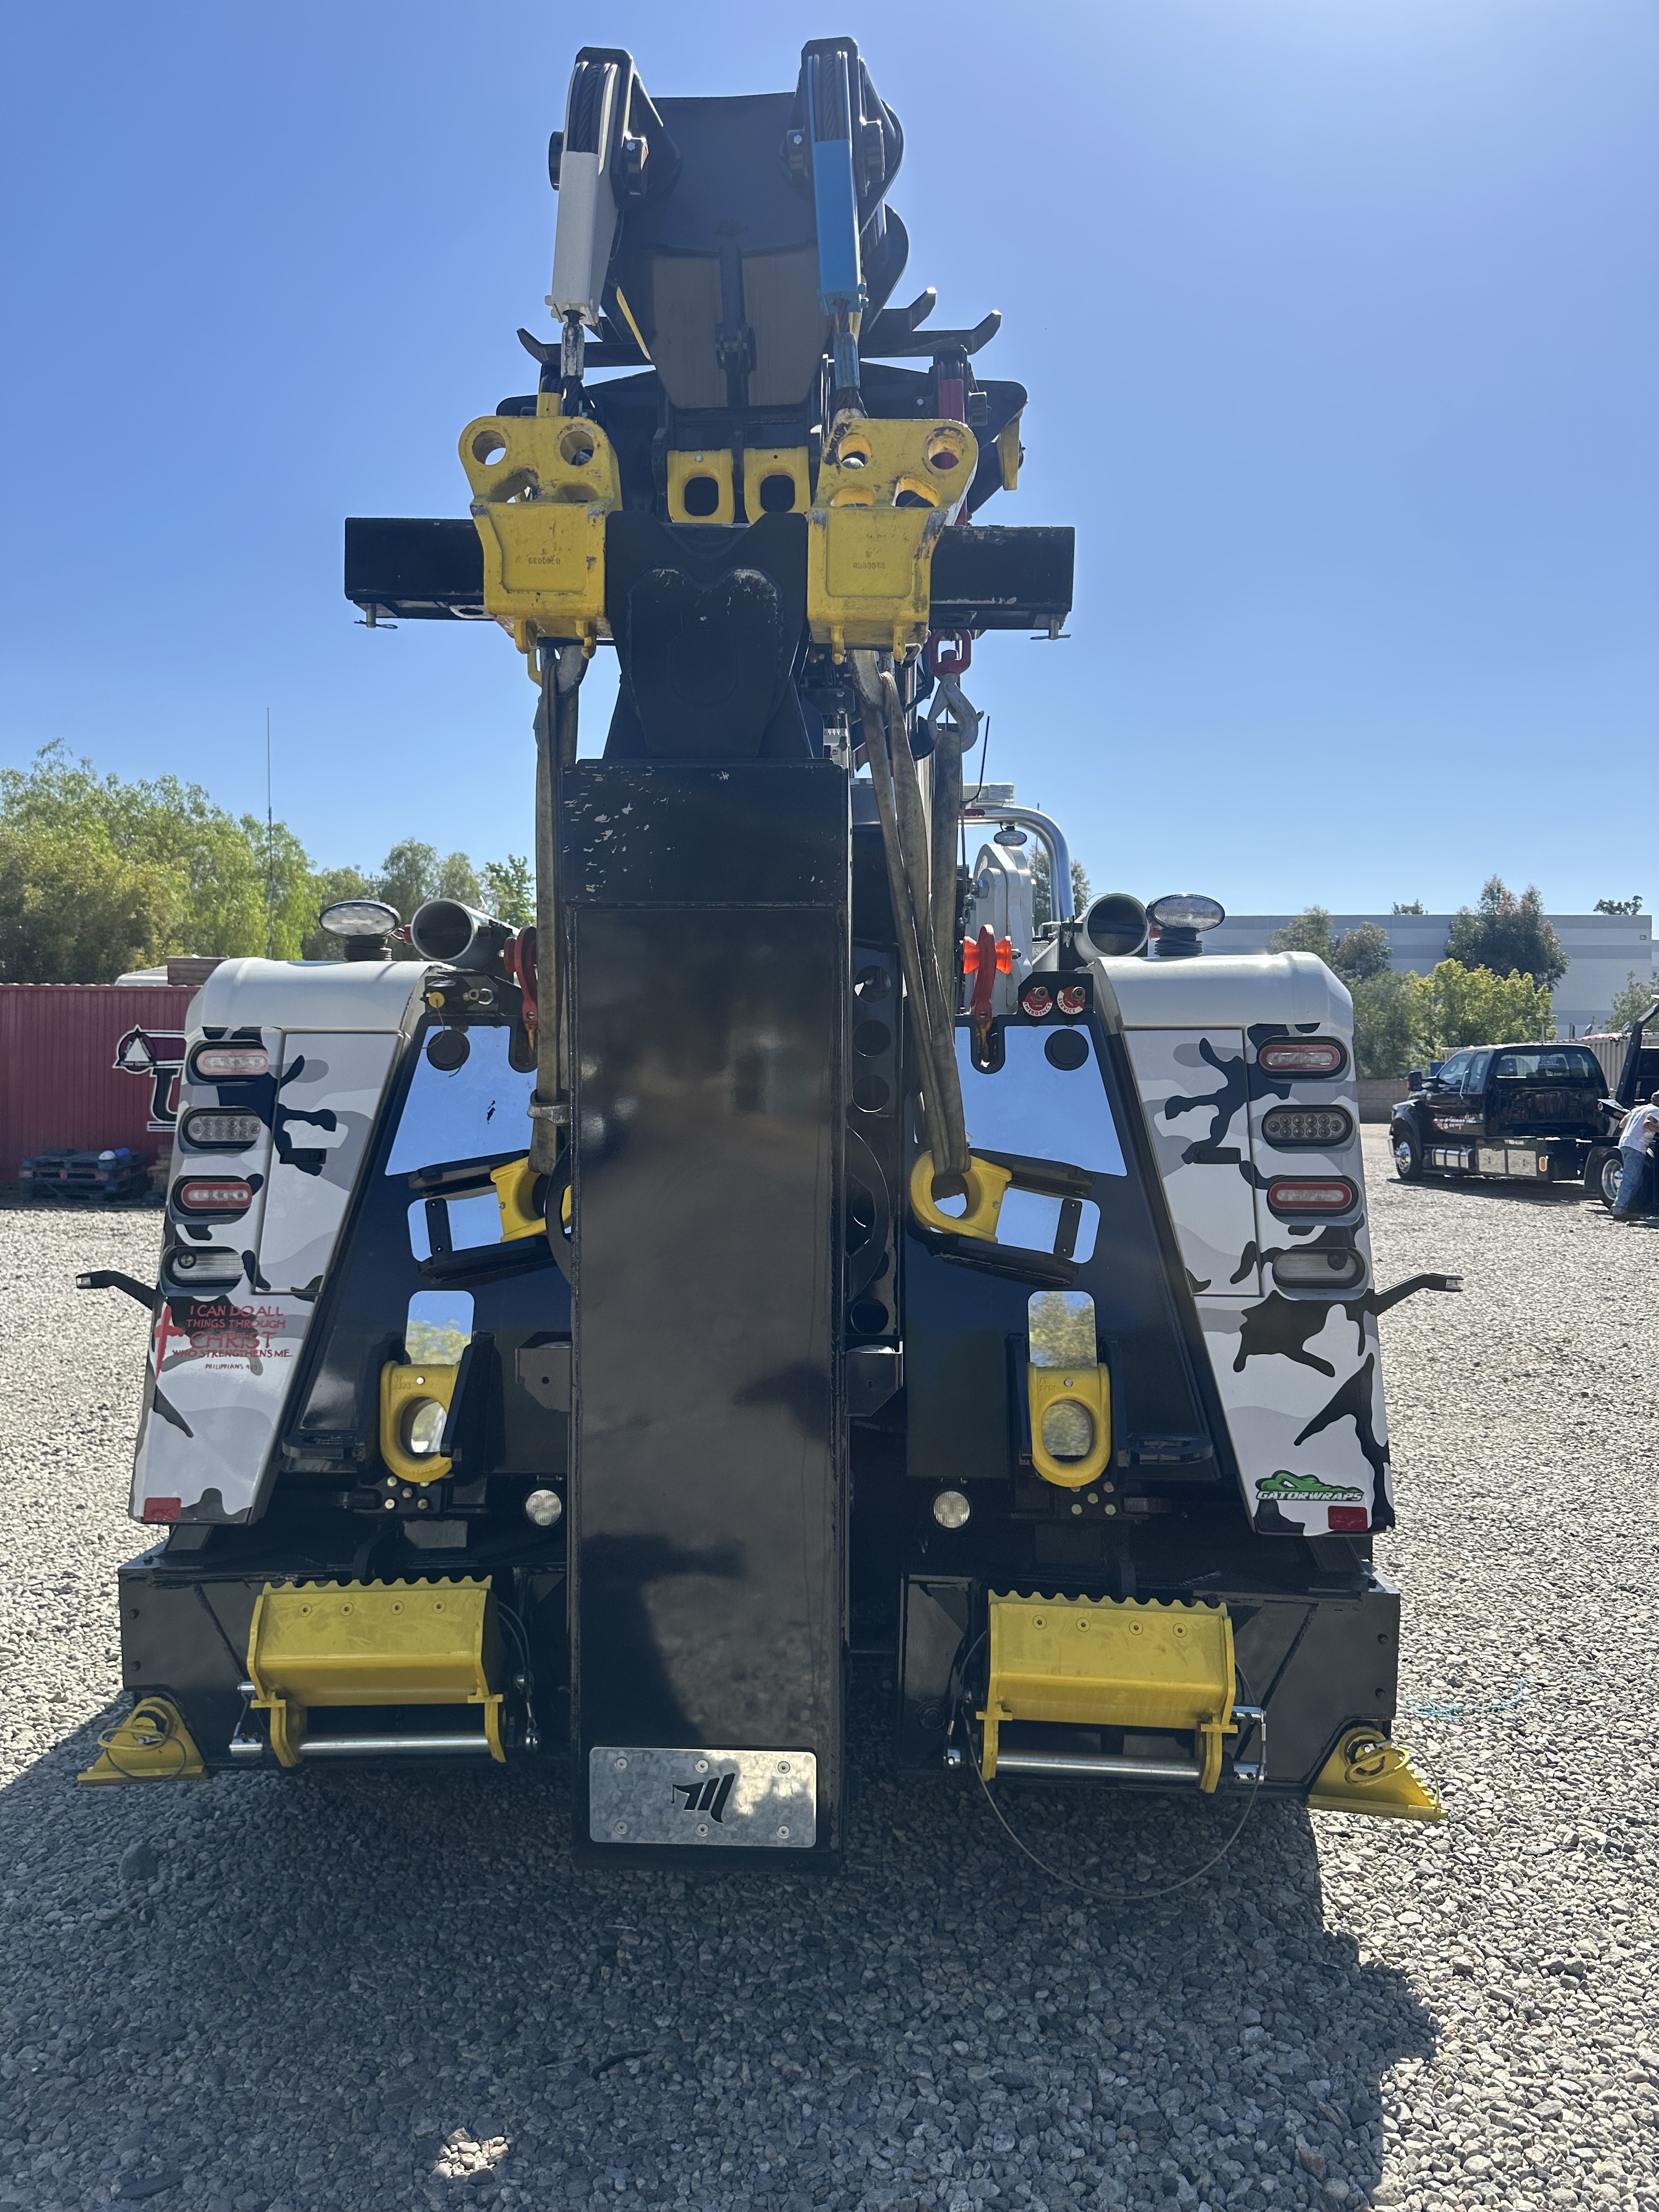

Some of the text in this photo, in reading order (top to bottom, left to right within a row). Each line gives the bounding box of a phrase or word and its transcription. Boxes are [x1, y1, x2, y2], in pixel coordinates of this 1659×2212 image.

[1024, 1002, 1051, 1015] EMERGENCY
[1058, 998, 1075, 1013] SERVICE
[190, 1305, 284, 1317] I CAN DO ALL
[186, 1318, 286, 1329] THINGS THROUGH
[190, 1330, 278, 1348] CHRIST
[172, 1348, 293, 1358] WHO STRENGTHENS ME.
[1256, 1491, 1364, 1501] GATORWRAPS
